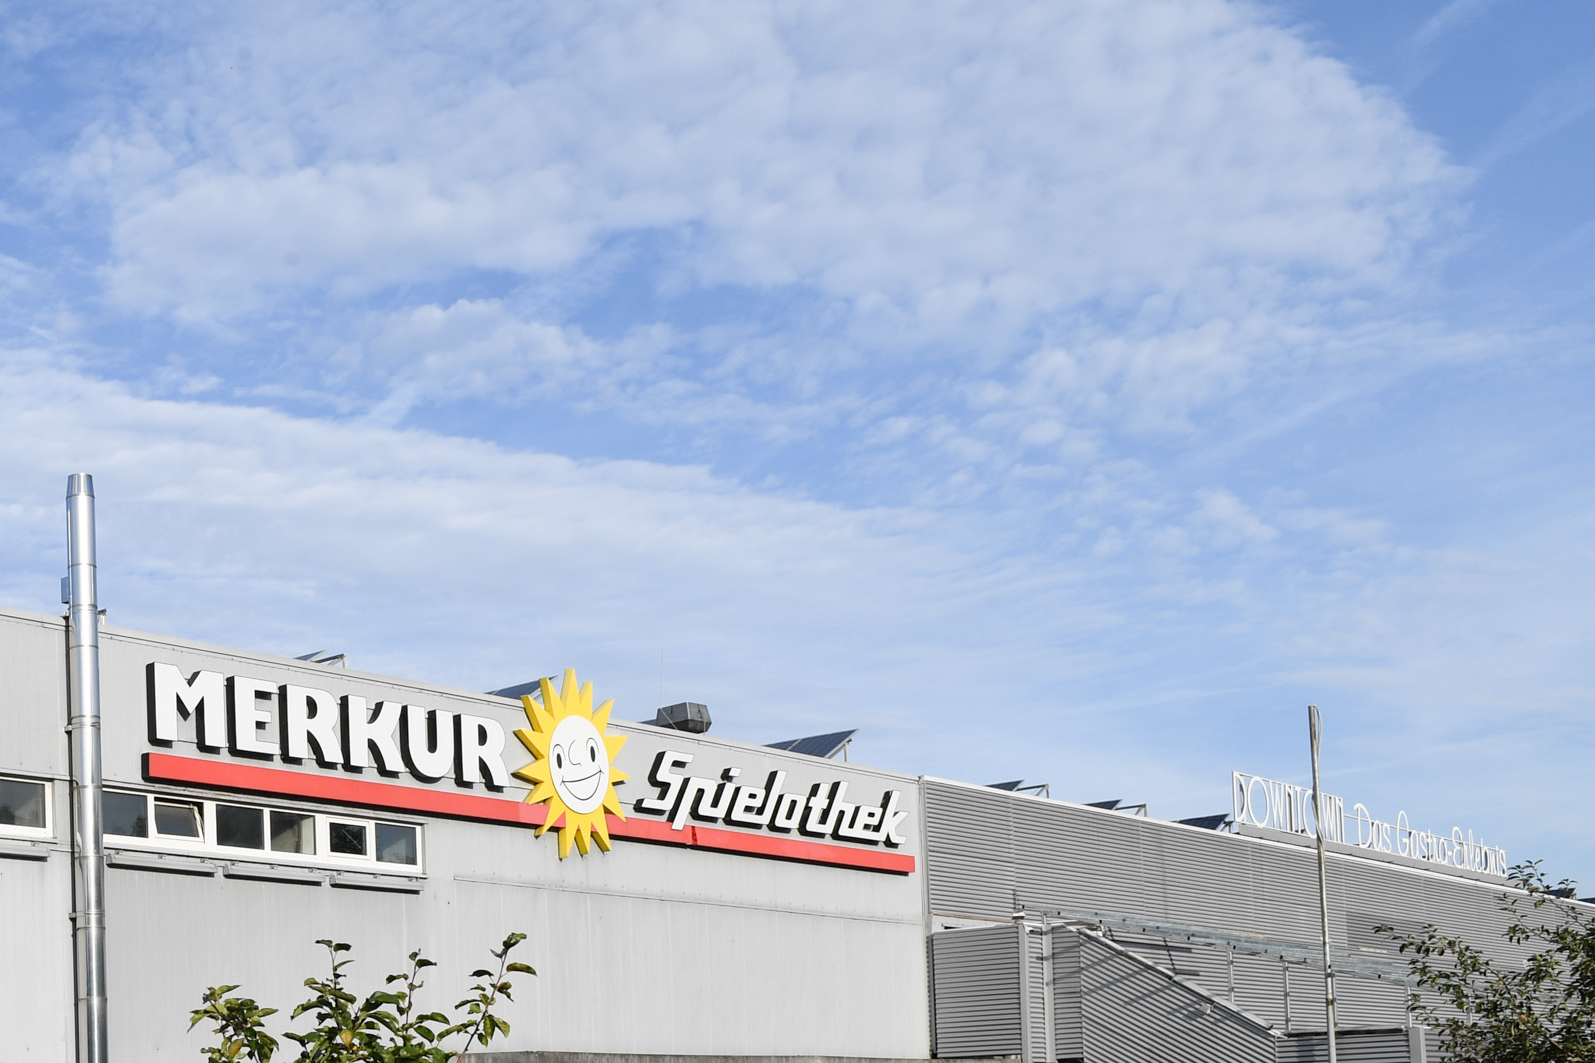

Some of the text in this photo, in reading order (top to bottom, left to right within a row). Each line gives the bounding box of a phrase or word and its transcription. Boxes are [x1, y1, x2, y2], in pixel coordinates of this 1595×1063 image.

[147, 661, 910, 848] MERKUR Spielothek
[1353, 803, 1392, 853] Das
[1396, 810, 1508, 877] Gastro-Erlebnis
